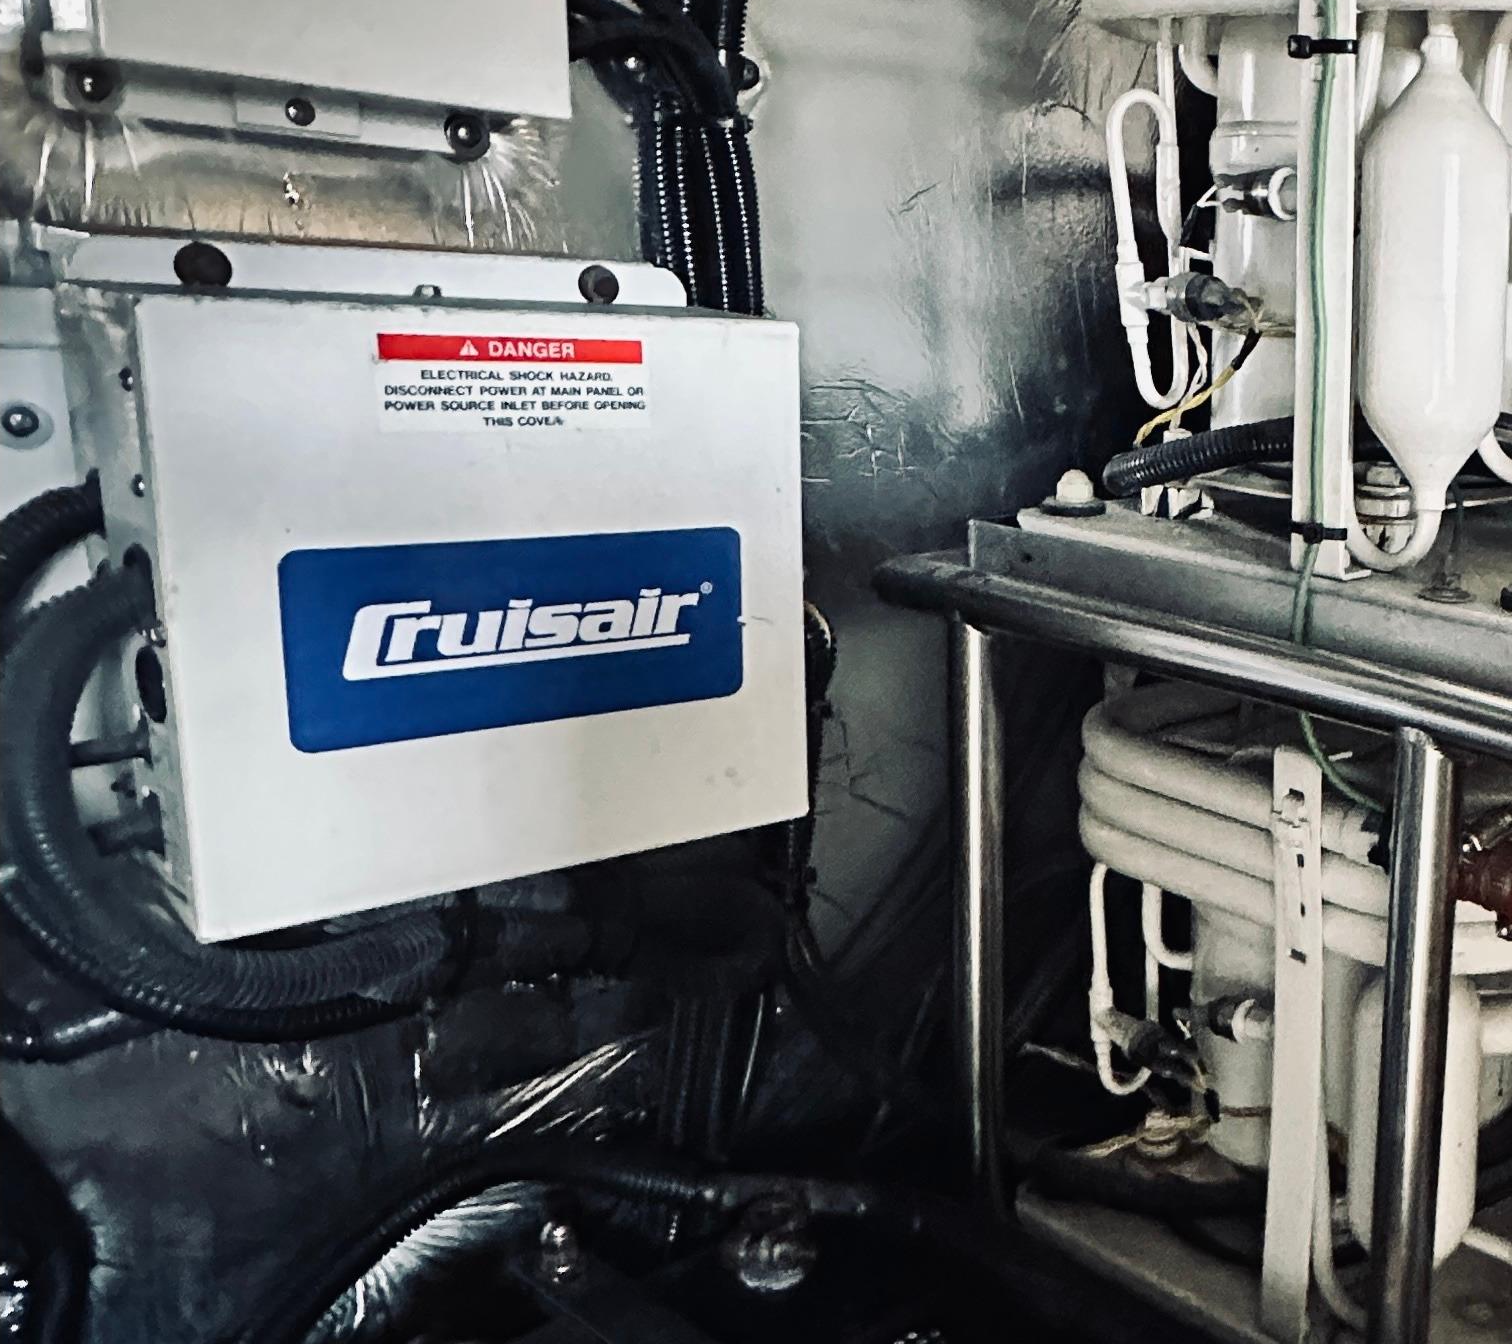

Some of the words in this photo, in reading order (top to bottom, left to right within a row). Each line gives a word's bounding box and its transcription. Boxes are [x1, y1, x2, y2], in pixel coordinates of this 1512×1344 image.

[488, 341, 575, 358] DANGER
[420, 369, 504, 381] ELECTRICAL
[509, 370, 554, 382] SHOCK
[384, 385, 473, 396] DISCONNECT
[480, 386, 526, 396] POWER
[532, 386, 547, 396] AT
[551, 386, 581, 396] MAIN
[586, 386, 623, 396] PANEL
[627, 386, 644, 396] OR
[384, 400, 435, 411] POWER
[440, 400, 495, 412] SOURCE
[501, 400, 537, 411] INLET
[541, 400, 589, 411] BEFORE
[594, 400, 646, 411] OPENING
[483, 416, 513, 427] THIS
